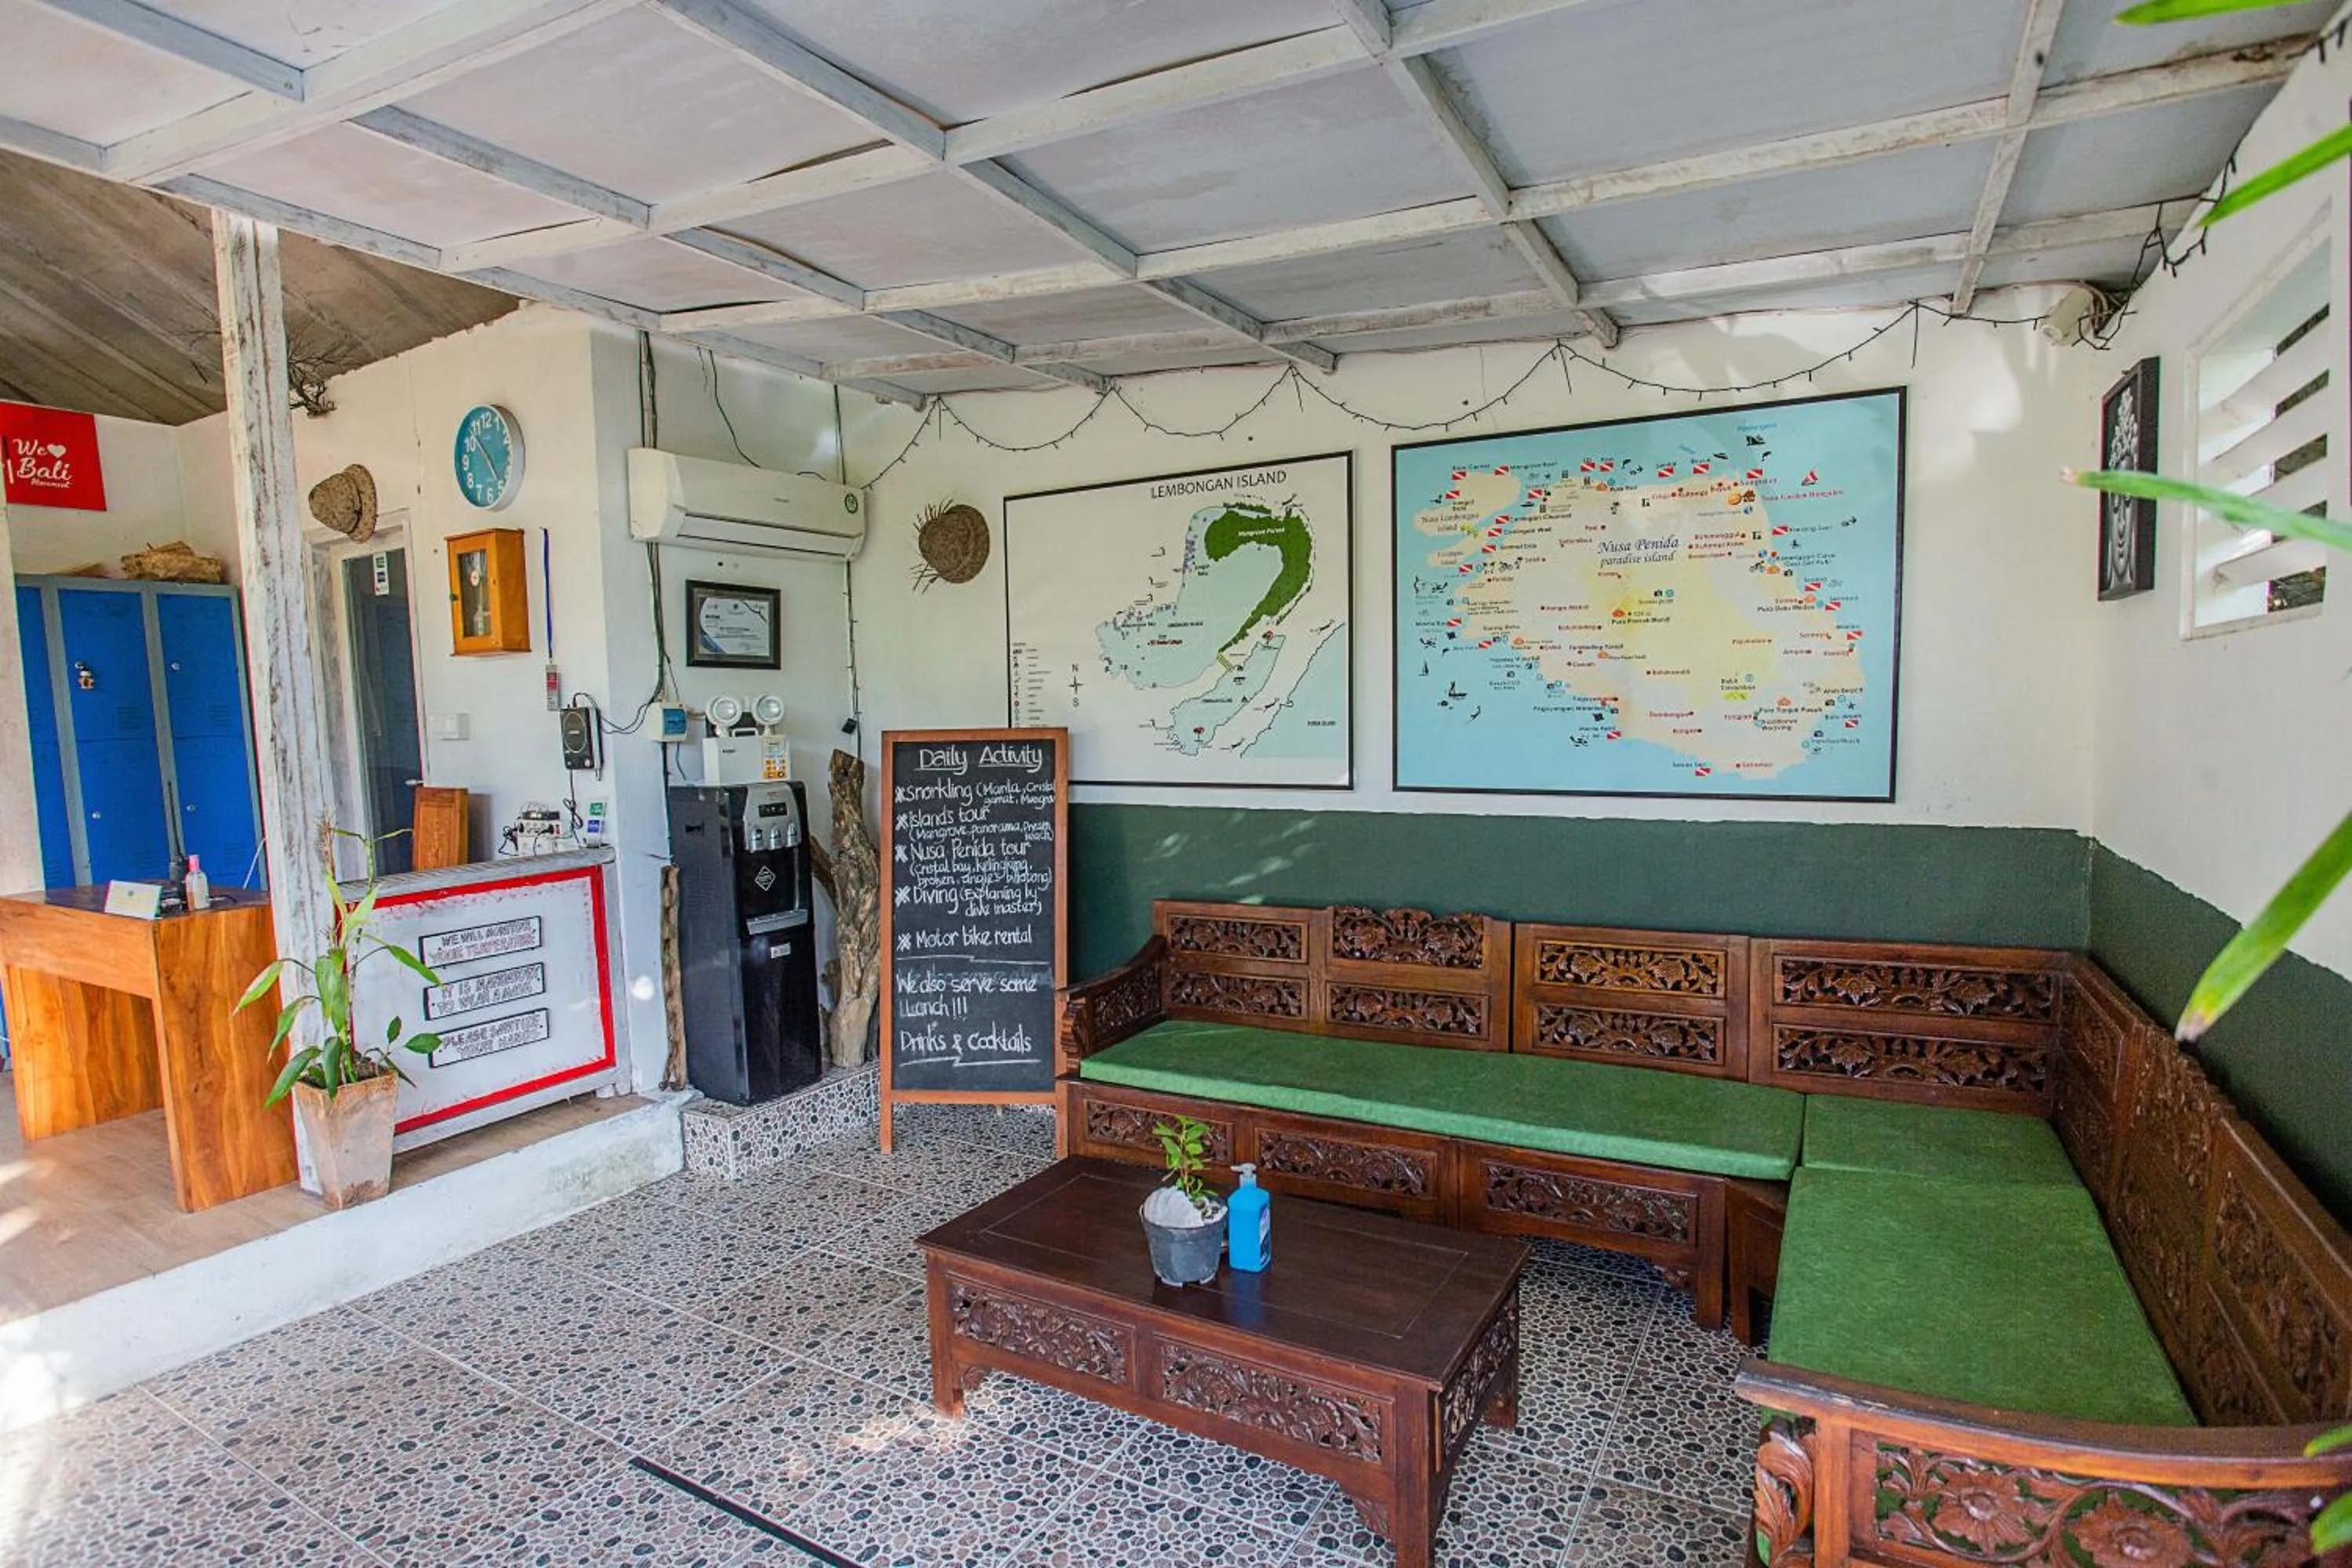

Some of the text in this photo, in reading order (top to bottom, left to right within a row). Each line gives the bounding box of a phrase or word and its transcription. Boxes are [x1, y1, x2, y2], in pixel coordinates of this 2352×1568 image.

[481, 412, 492, 428] 12
[13, 438, 47, 455] We
[464, 435, 476, 452] 10
[16, 457, 72, 481] Bali
[463, 454, 469, 471] 9
[467, 472, 474, 488] 8
[1150, 476, 1233, 499] LEMBONGAN
[1236, 470, 1287, 488] ISLAND
[476, 484, 482, 502] 7
[487, 488, 494, 503] 6
[1597, 538, 1632, 554] Nusa
[1635, 534, 1679, 550] Penida
[1599, 550, 1677, 568] paradise island
[1072, 663, 1079, 673] N
[1072, 697, 1080, 708] S
[920, 744, 1043, 775] Daily Activity
[958, 807, 990, 822] tour
[910, 837, 1032, 861] Nusa Penida tour
[913, 887, 960, 915] Diving
[461, 929, 483, 943] WILL
[916, 924, 1033, 947] Motor bike rental
[896, 969, 1037, 994] We also serve some
[901, 1022, 946, 1054] Drinks
[967, 1020, 1033, 1054] Cocktails
